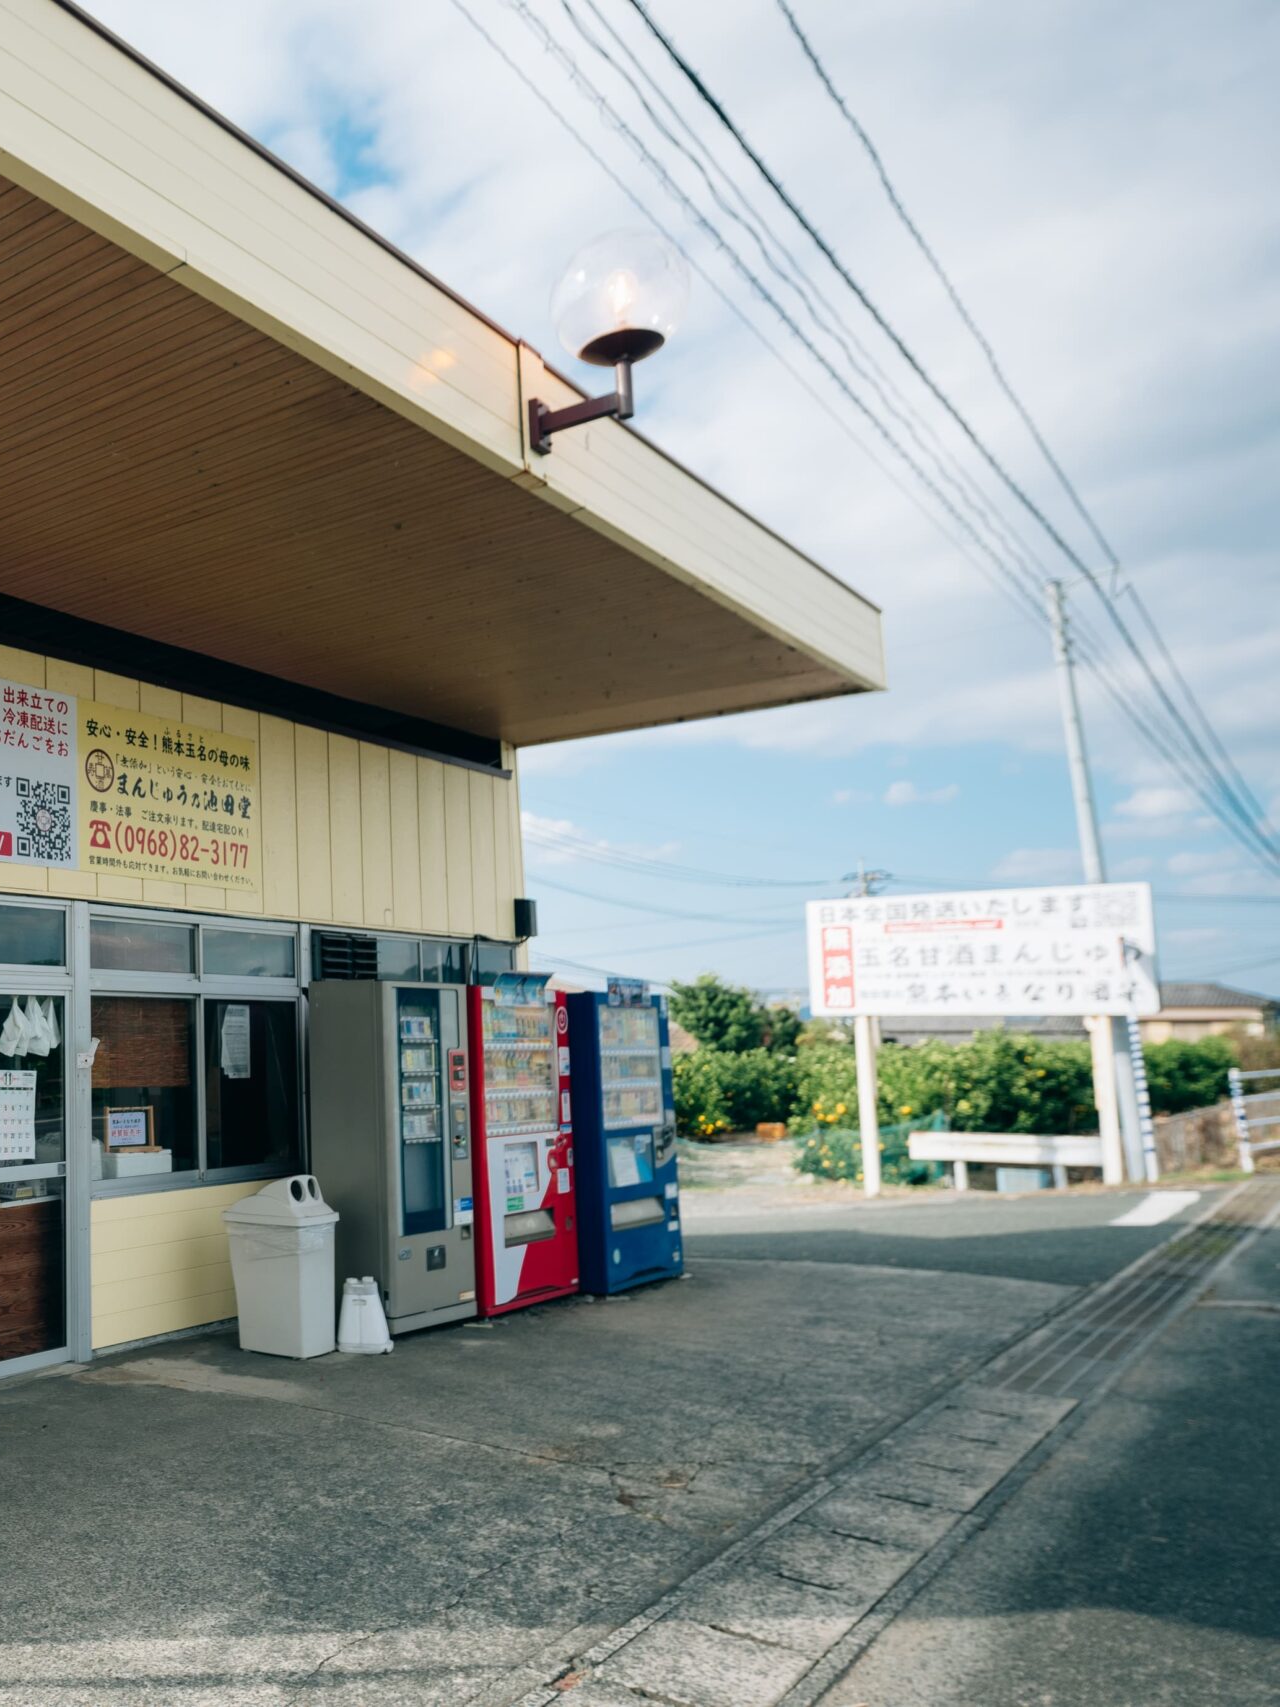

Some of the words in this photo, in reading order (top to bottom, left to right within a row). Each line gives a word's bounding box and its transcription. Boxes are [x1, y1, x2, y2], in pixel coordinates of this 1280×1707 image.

[86, 718, 251, 771] 安心・安全！熊本玉名の母の味
[115, 821, 249, 869] (0968)82-3177
[820, 894, 1084, 925] 日本全国発送いたします
